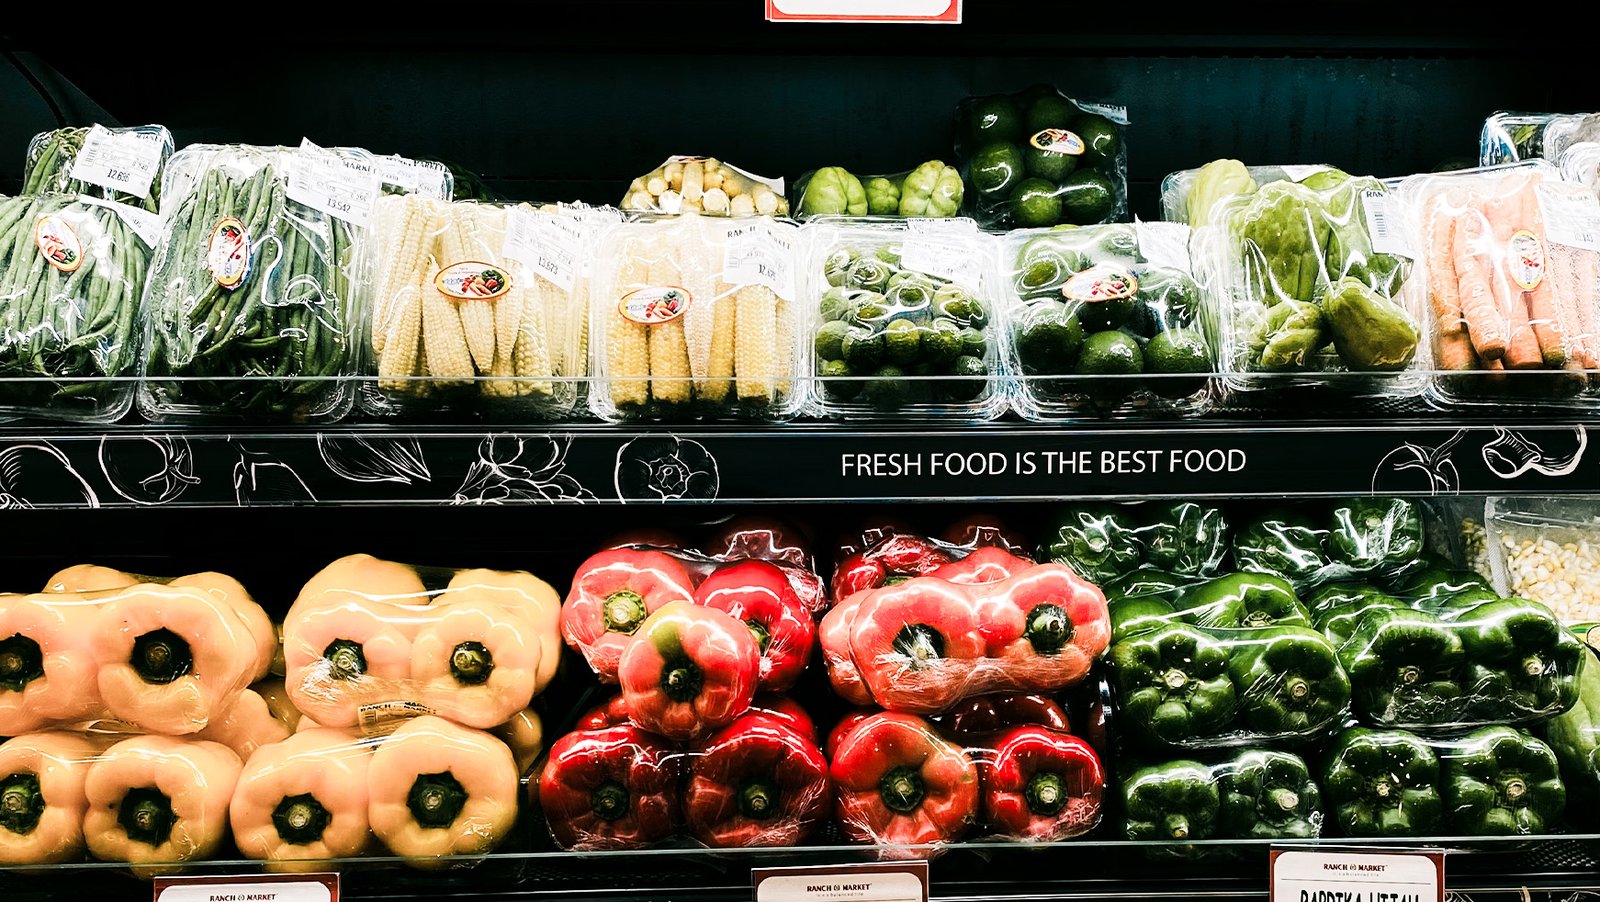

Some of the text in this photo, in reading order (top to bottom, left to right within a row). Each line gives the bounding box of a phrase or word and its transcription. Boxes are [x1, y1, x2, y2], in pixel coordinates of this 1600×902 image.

[841, 449, 1247, 477] FRESH FOOD IS THE BEST FOOD
[1323, 863, 1386, 872] RANCH MARKET
[209, 894, 236, 902] RANCH
